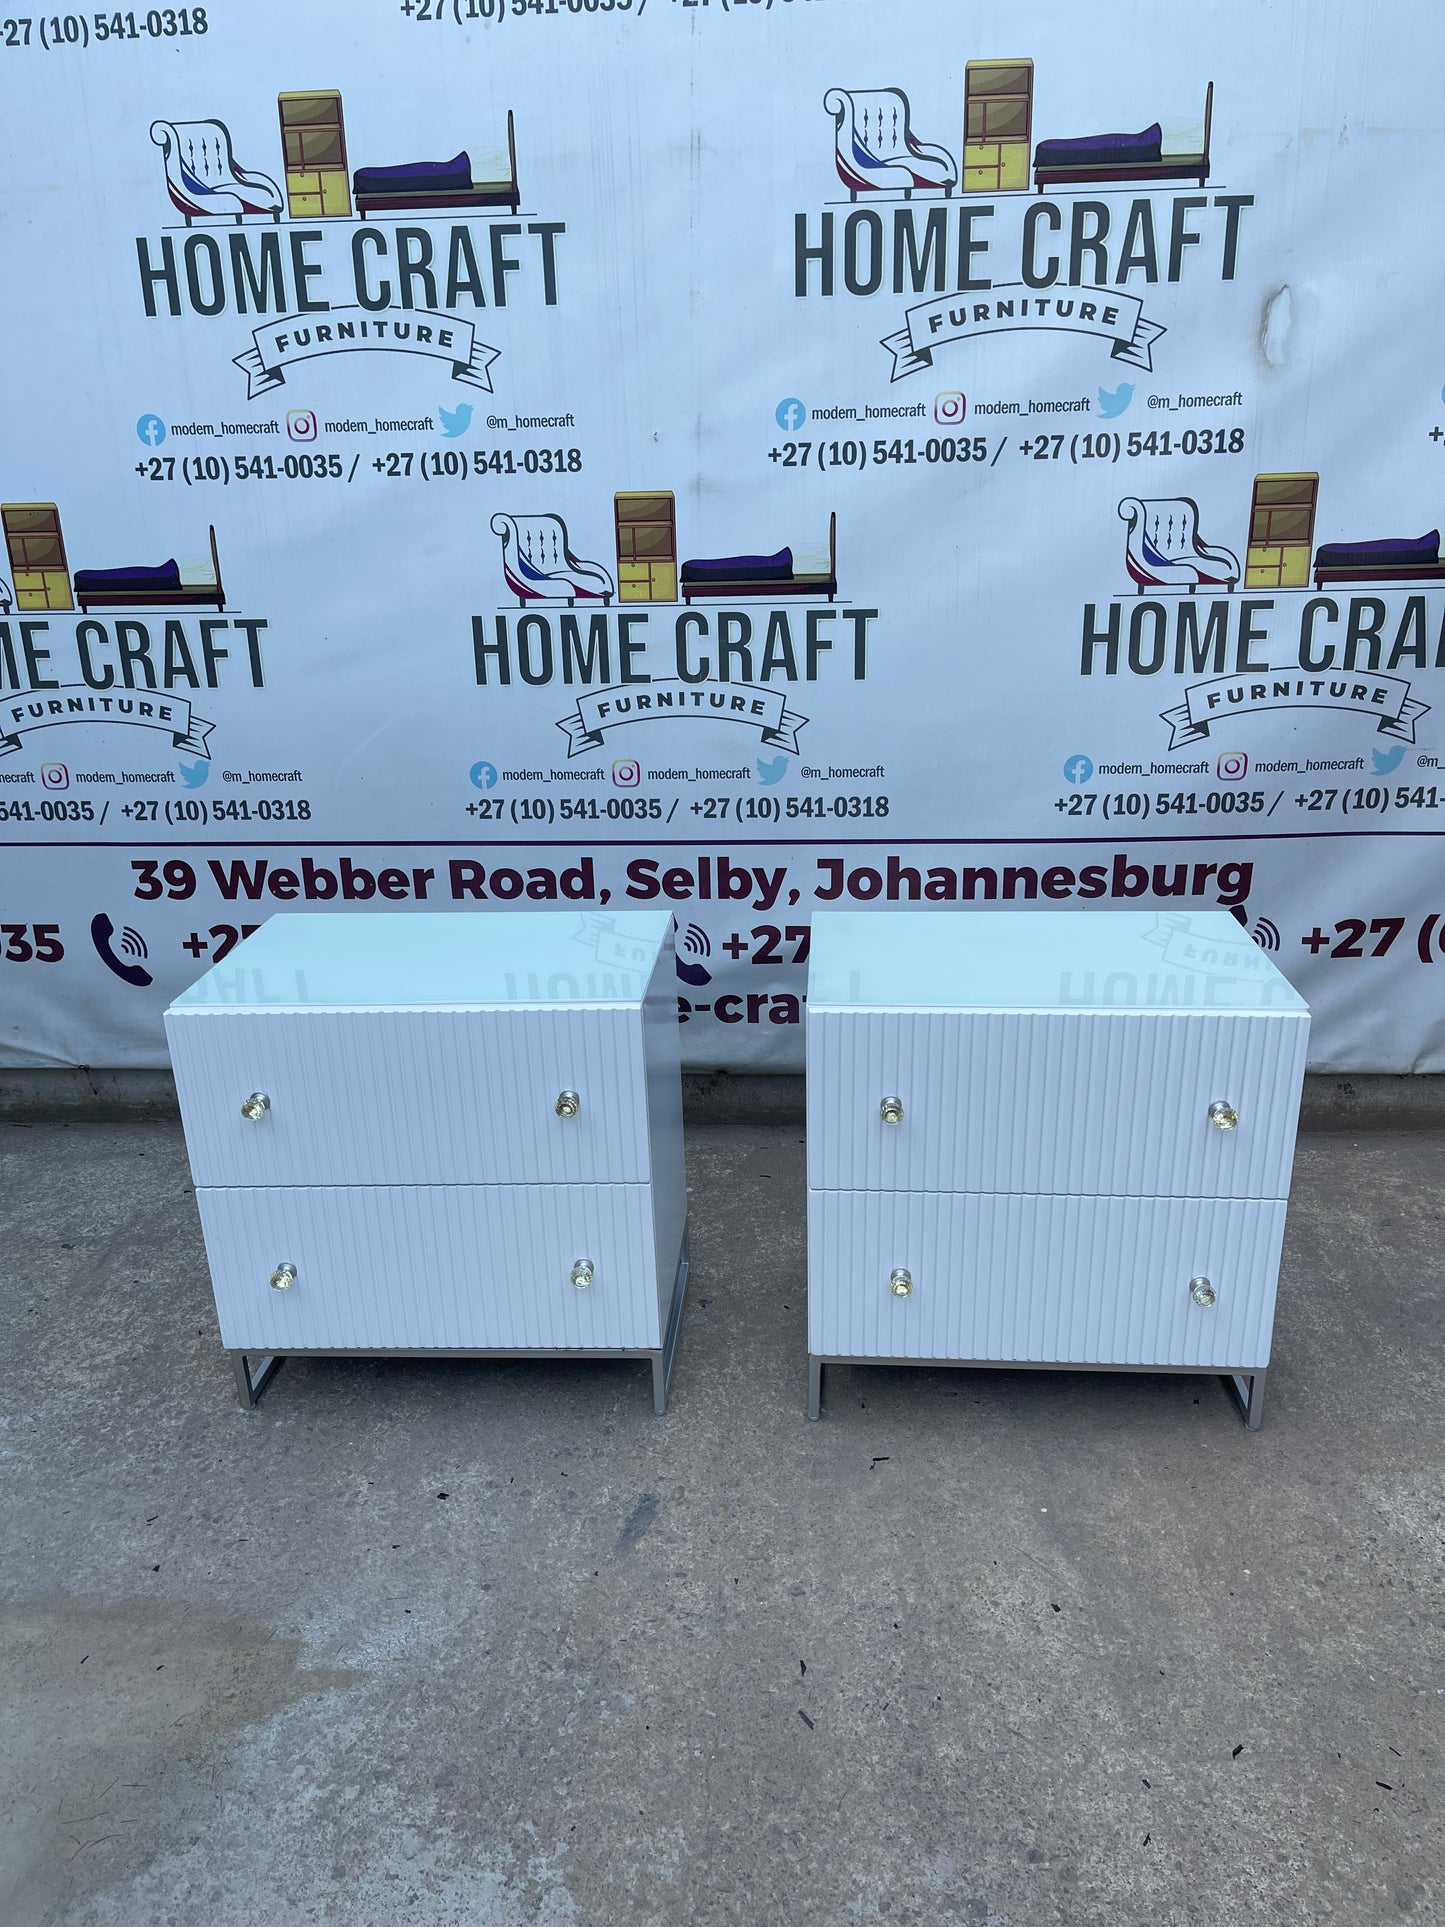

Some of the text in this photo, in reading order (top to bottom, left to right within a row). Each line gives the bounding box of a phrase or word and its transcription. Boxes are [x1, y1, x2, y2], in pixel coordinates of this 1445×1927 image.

[0, 8, 208, 50] 27 (10) 541-0318
[401, 0, 443, 21] +27
[454, 0, 505, 25] (10)
[795, 195, 1254, 297] HOME CRAFT
[136, 222, 566, 317] HOME CRAFT
[929, 299, 1119, 333] FURNITURE
[275, 321, 454, 352] FURNITURE
[1148, 392, 1242, 410] @m_homecraft
[487, 413, 575, 431] @m_homecraft
[768, 428, 1244, 471] +27 (10) 541-0035 / +27 (10) 541-0318
[135, 449, 582, 485] +27 (10) 541-0035 / +27 (10) 541-0318
[472, 609, 878, 685] HOME CRAFT
[1081, 600, 1275, 675] HOME
[76, 620, 268, 690] CRAFT
[11, 698, 172, 722] FURNITURE
[598, 691, 765, 718] FURNITURE
[1207, 681, 1388, 708] FURNITURE
[223, 770, 302, 784] @m_homecraft
[801, 765, 884, 780] @m_homecraft
[0, 800, 311, 825] 541-0035 / +27 (10) 541-0318
[466, 796, 889, 824] +27 (10) 541-0035 / +27 (10) 541-0318
[1055, 794, 1097, 815] +27
[1103, 794, 1150, 820] (10)
[1156, 792, 1264, 814] 541-0035
[1267, 791, 1284, 816] /
[1295, 789, 1338, 810] +27
[1342, 788, 1389, 814] (10)
[131, 854, 1254, 911] 39 Webber Road, Selby, Johannesburg
[0, 923, 65, 963] 35
[721, 924, 811, 965] +27
[1301, 917, 1405, 959] +27
